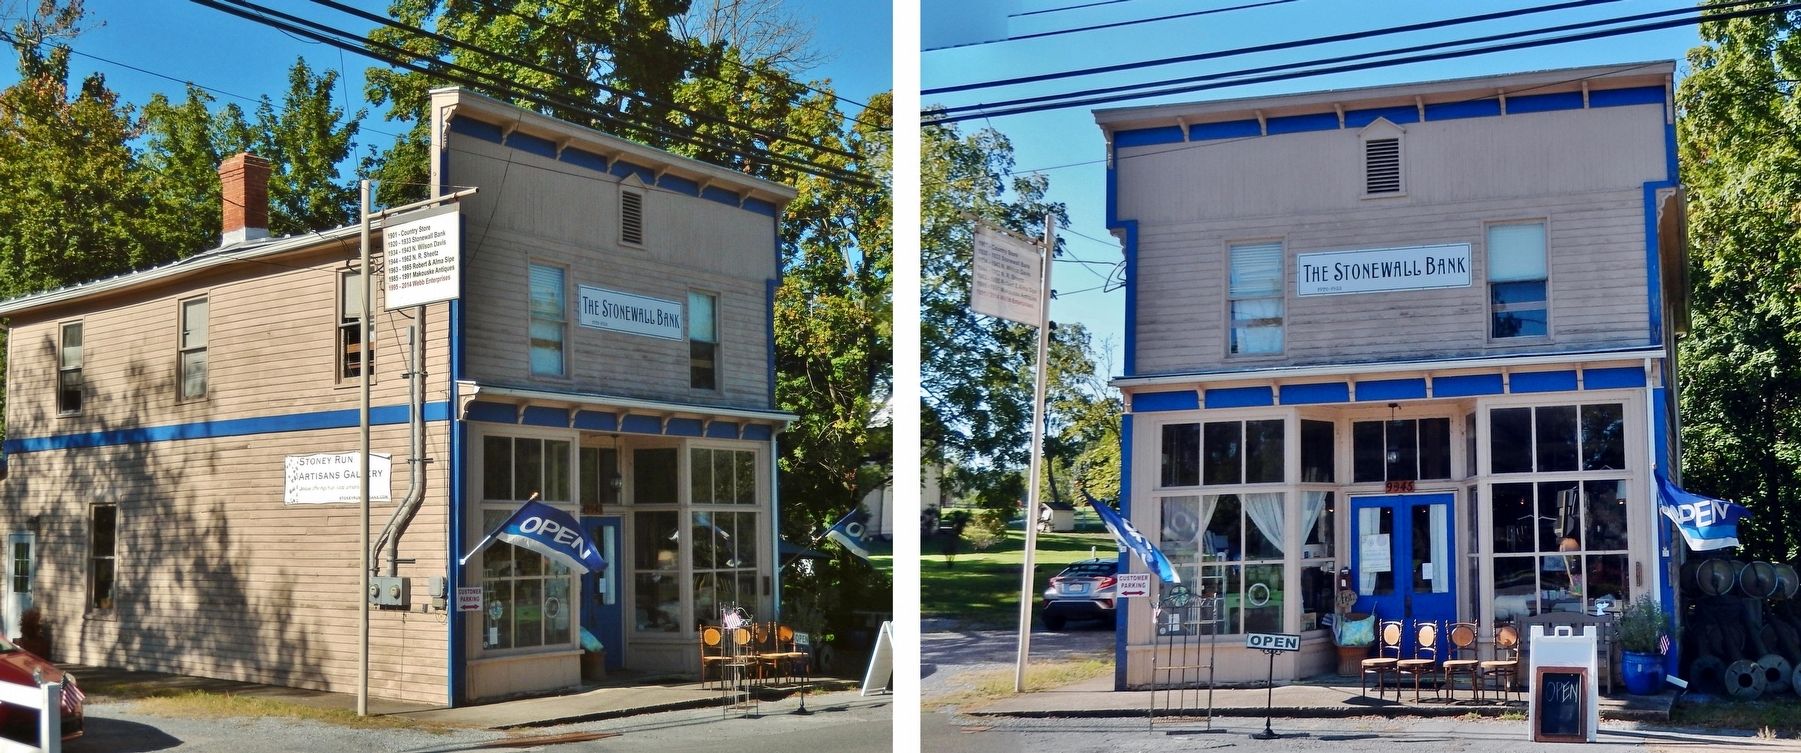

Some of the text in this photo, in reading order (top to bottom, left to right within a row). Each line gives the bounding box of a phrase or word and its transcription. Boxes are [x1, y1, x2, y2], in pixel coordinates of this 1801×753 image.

[401, 227, 418, 236] Country
[401, 237, 411, 245] 1933
[412, 233, 434, 243] Stonewall
[434, 230, 446, 238] Bank
[402, 246, 411, 254] 1943
[418, 242, 433, 250] Wilson
[434, 239, 447, 248] Davis
[413, 260, 428, 269] Robert
[445, 256, 455, 264] Sipe
[435, 265, 455, 274] Antiques
[1303, 256, 1466, 283] THE STONEWALL BANK
[412, 279, 425, 287] Webb
[426, 275, 451, 284] Enterprises
[582, 296, 680, 329] THE STONEWALL BANK
[299, 455, 353, 466] STONEY RUN
[299, 469, 383, 480] ARTISANS GALRY
[520, 516, 592, 560] OPEN
[1250, 635, 1297, 649] OPEN
[1546, 680, 1578, 703] OPEN
